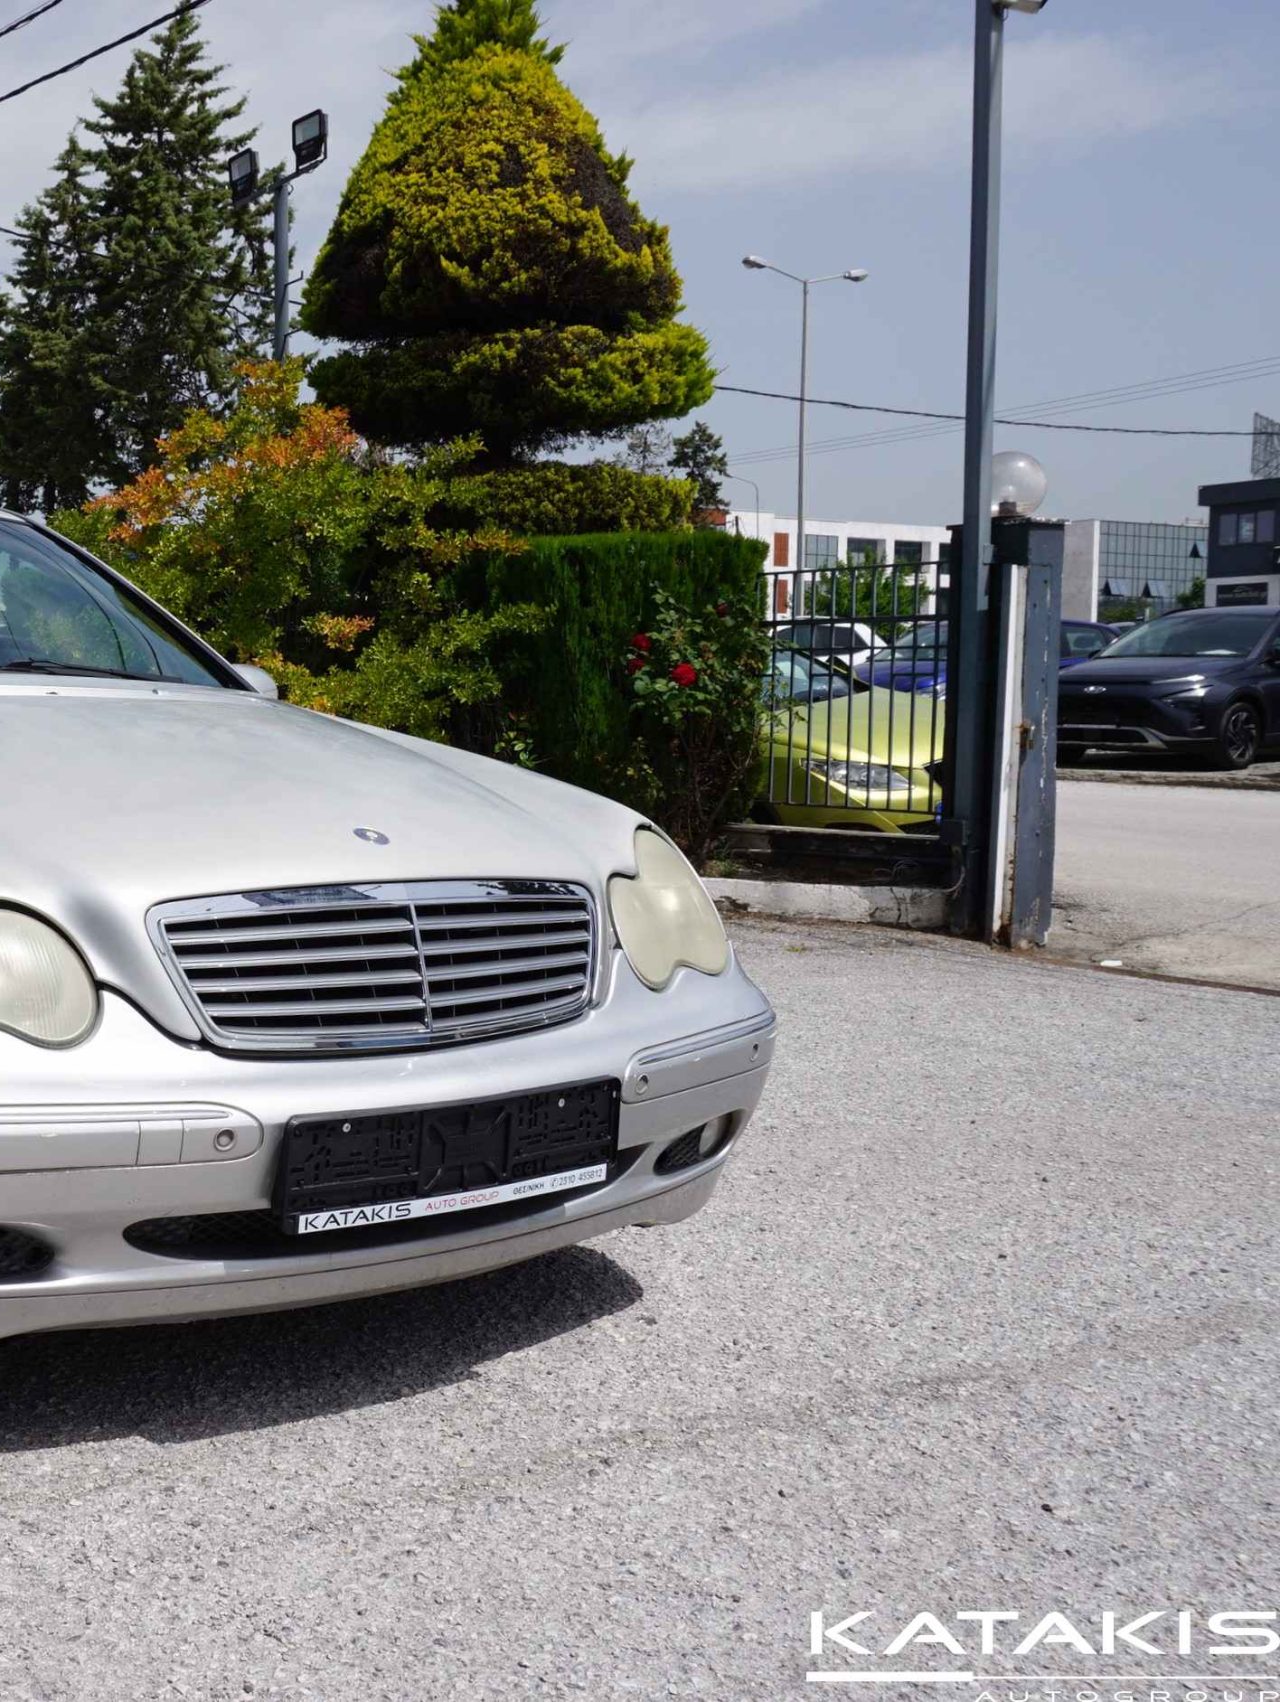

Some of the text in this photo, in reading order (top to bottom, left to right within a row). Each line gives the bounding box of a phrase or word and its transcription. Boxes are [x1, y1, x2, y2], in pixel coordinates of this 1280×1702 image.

[304, 1190, 499, 1231] KATAKIS AUTO GROUP
